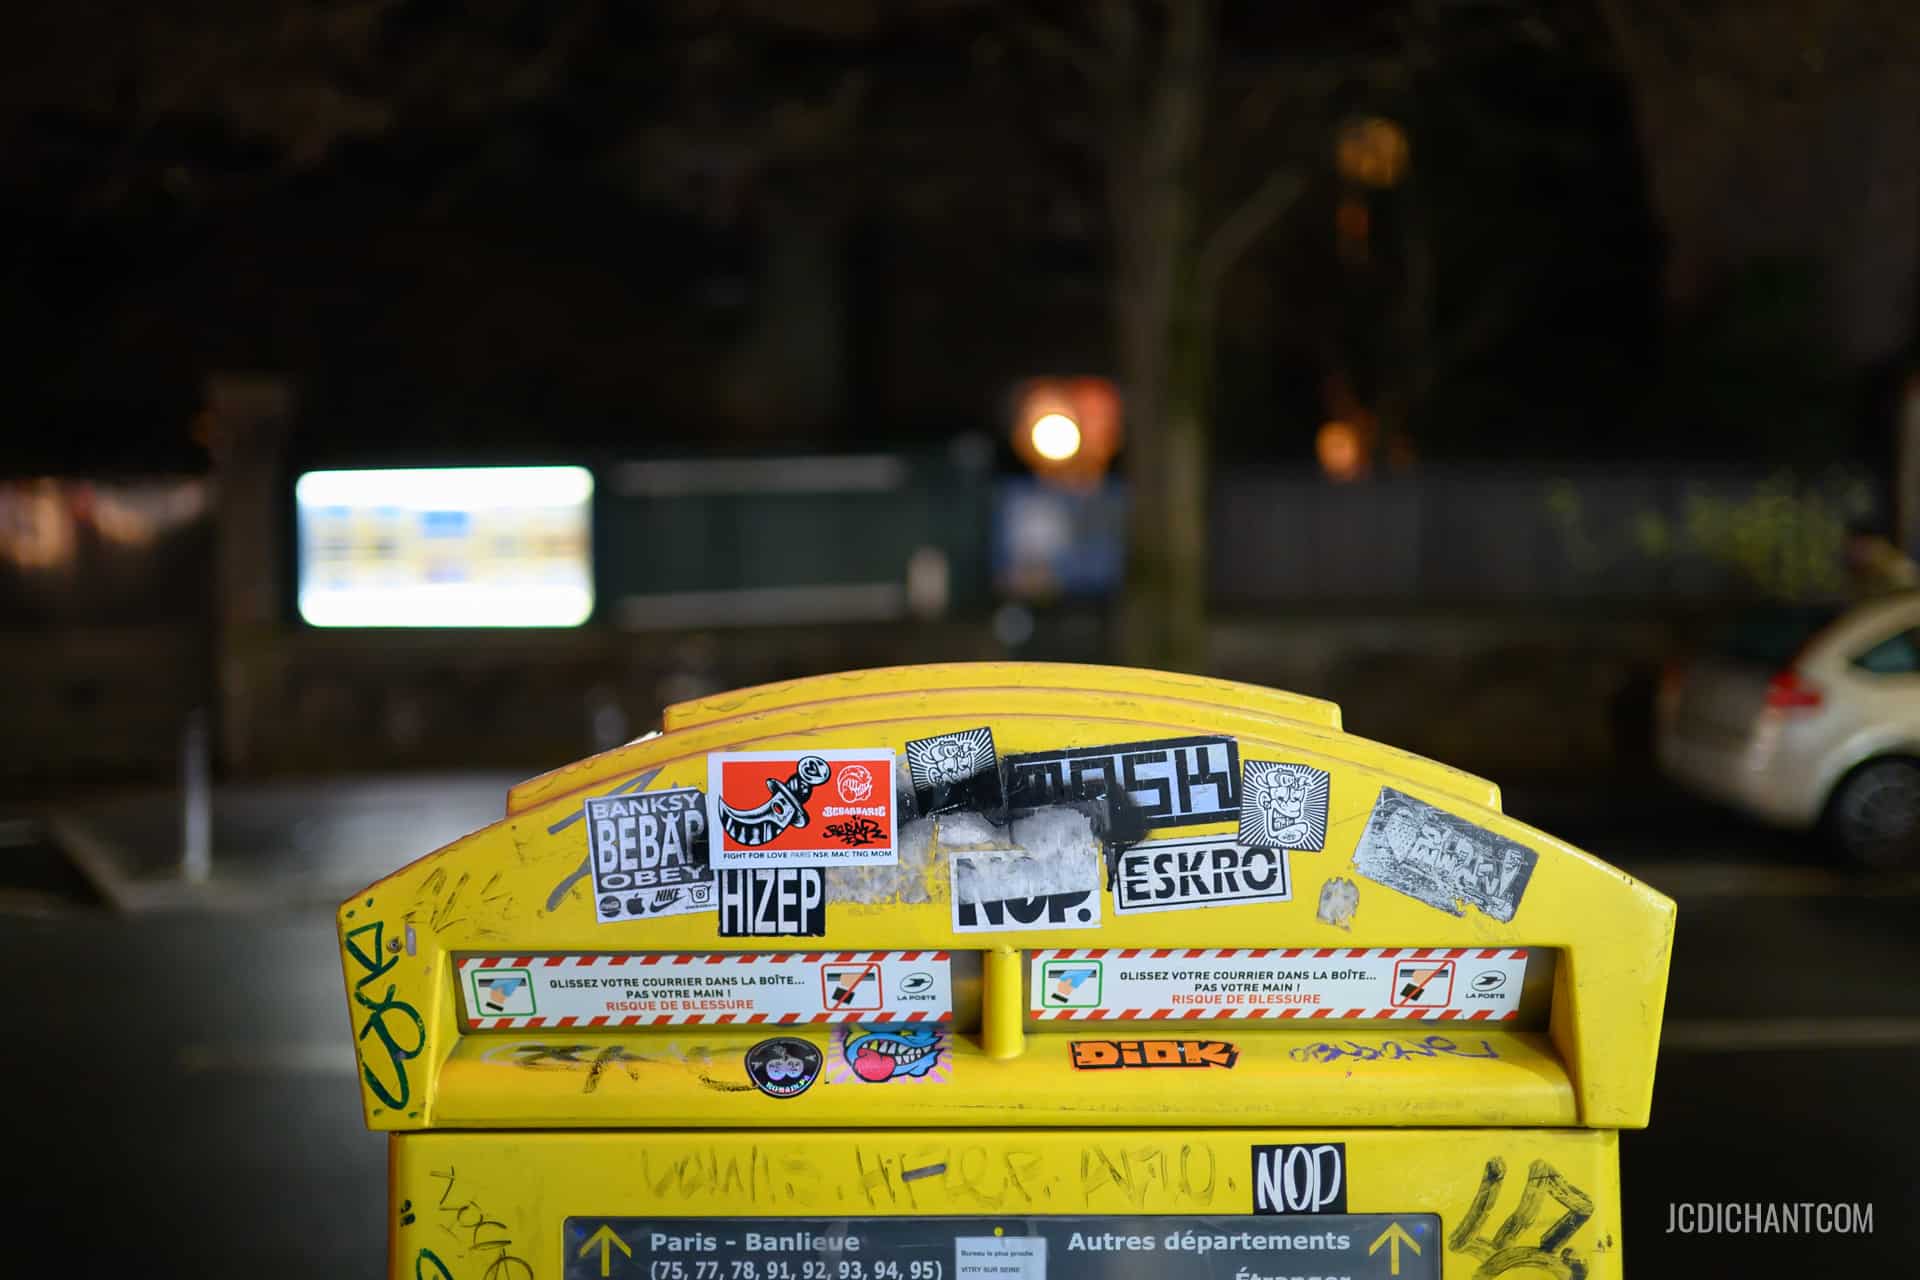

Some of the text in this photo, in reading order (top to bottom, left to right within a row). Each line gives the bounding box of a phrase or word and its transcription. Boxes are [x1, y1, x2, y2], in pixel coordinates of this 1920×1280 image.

[592, 792, 700, 820] BANKSY
[723, 852, 746, 860] FIGHT
[601, 864, 705, 889] OBEY
[1124, 848, 1278, 901] ESKRO
[655, 887, 681, 902] NIKE
[722, 868, 822, 934] HIZEP
[601, 978, 639, 988] VOTRE
[642, 977, 701, 987] COURRIER
[705, 976, 738, 986] DANS
[741, 976, 756, 986] LA
[1172, 971, 1210, 981] VOTRE
[1213, 971, 1273, 980] COURRIER
[1277, 971, 1309, 980] DANS
[1312, 971, 1328, 980] LA
[626, 990, 650, 999] PAS
[652, 990, 690, 999] VOTRE
[693, 989, 724, 998] MAIN
[1195, 983, 1217, 992] PAS
[1221, 983, 1259, 992] VOTRE
[1262, 983, 1291, 992] MAIN
[605, 999, 754, 1011] RISQUE DE BLESSURE
[1171, 994, 1321, 1005] RISQUE DE BLESSURE
[1256, 1144, 1343, 1213] NOP
[650, 1232, 717, 1251] Paris
[745, 1232, 860, 1251] Banlieue
[1068, 1230, 1351, 1255] Autres départements
[651, 1260, 943, 1280] (75, 77, 78, 91, 92, 93, 94, 95)
